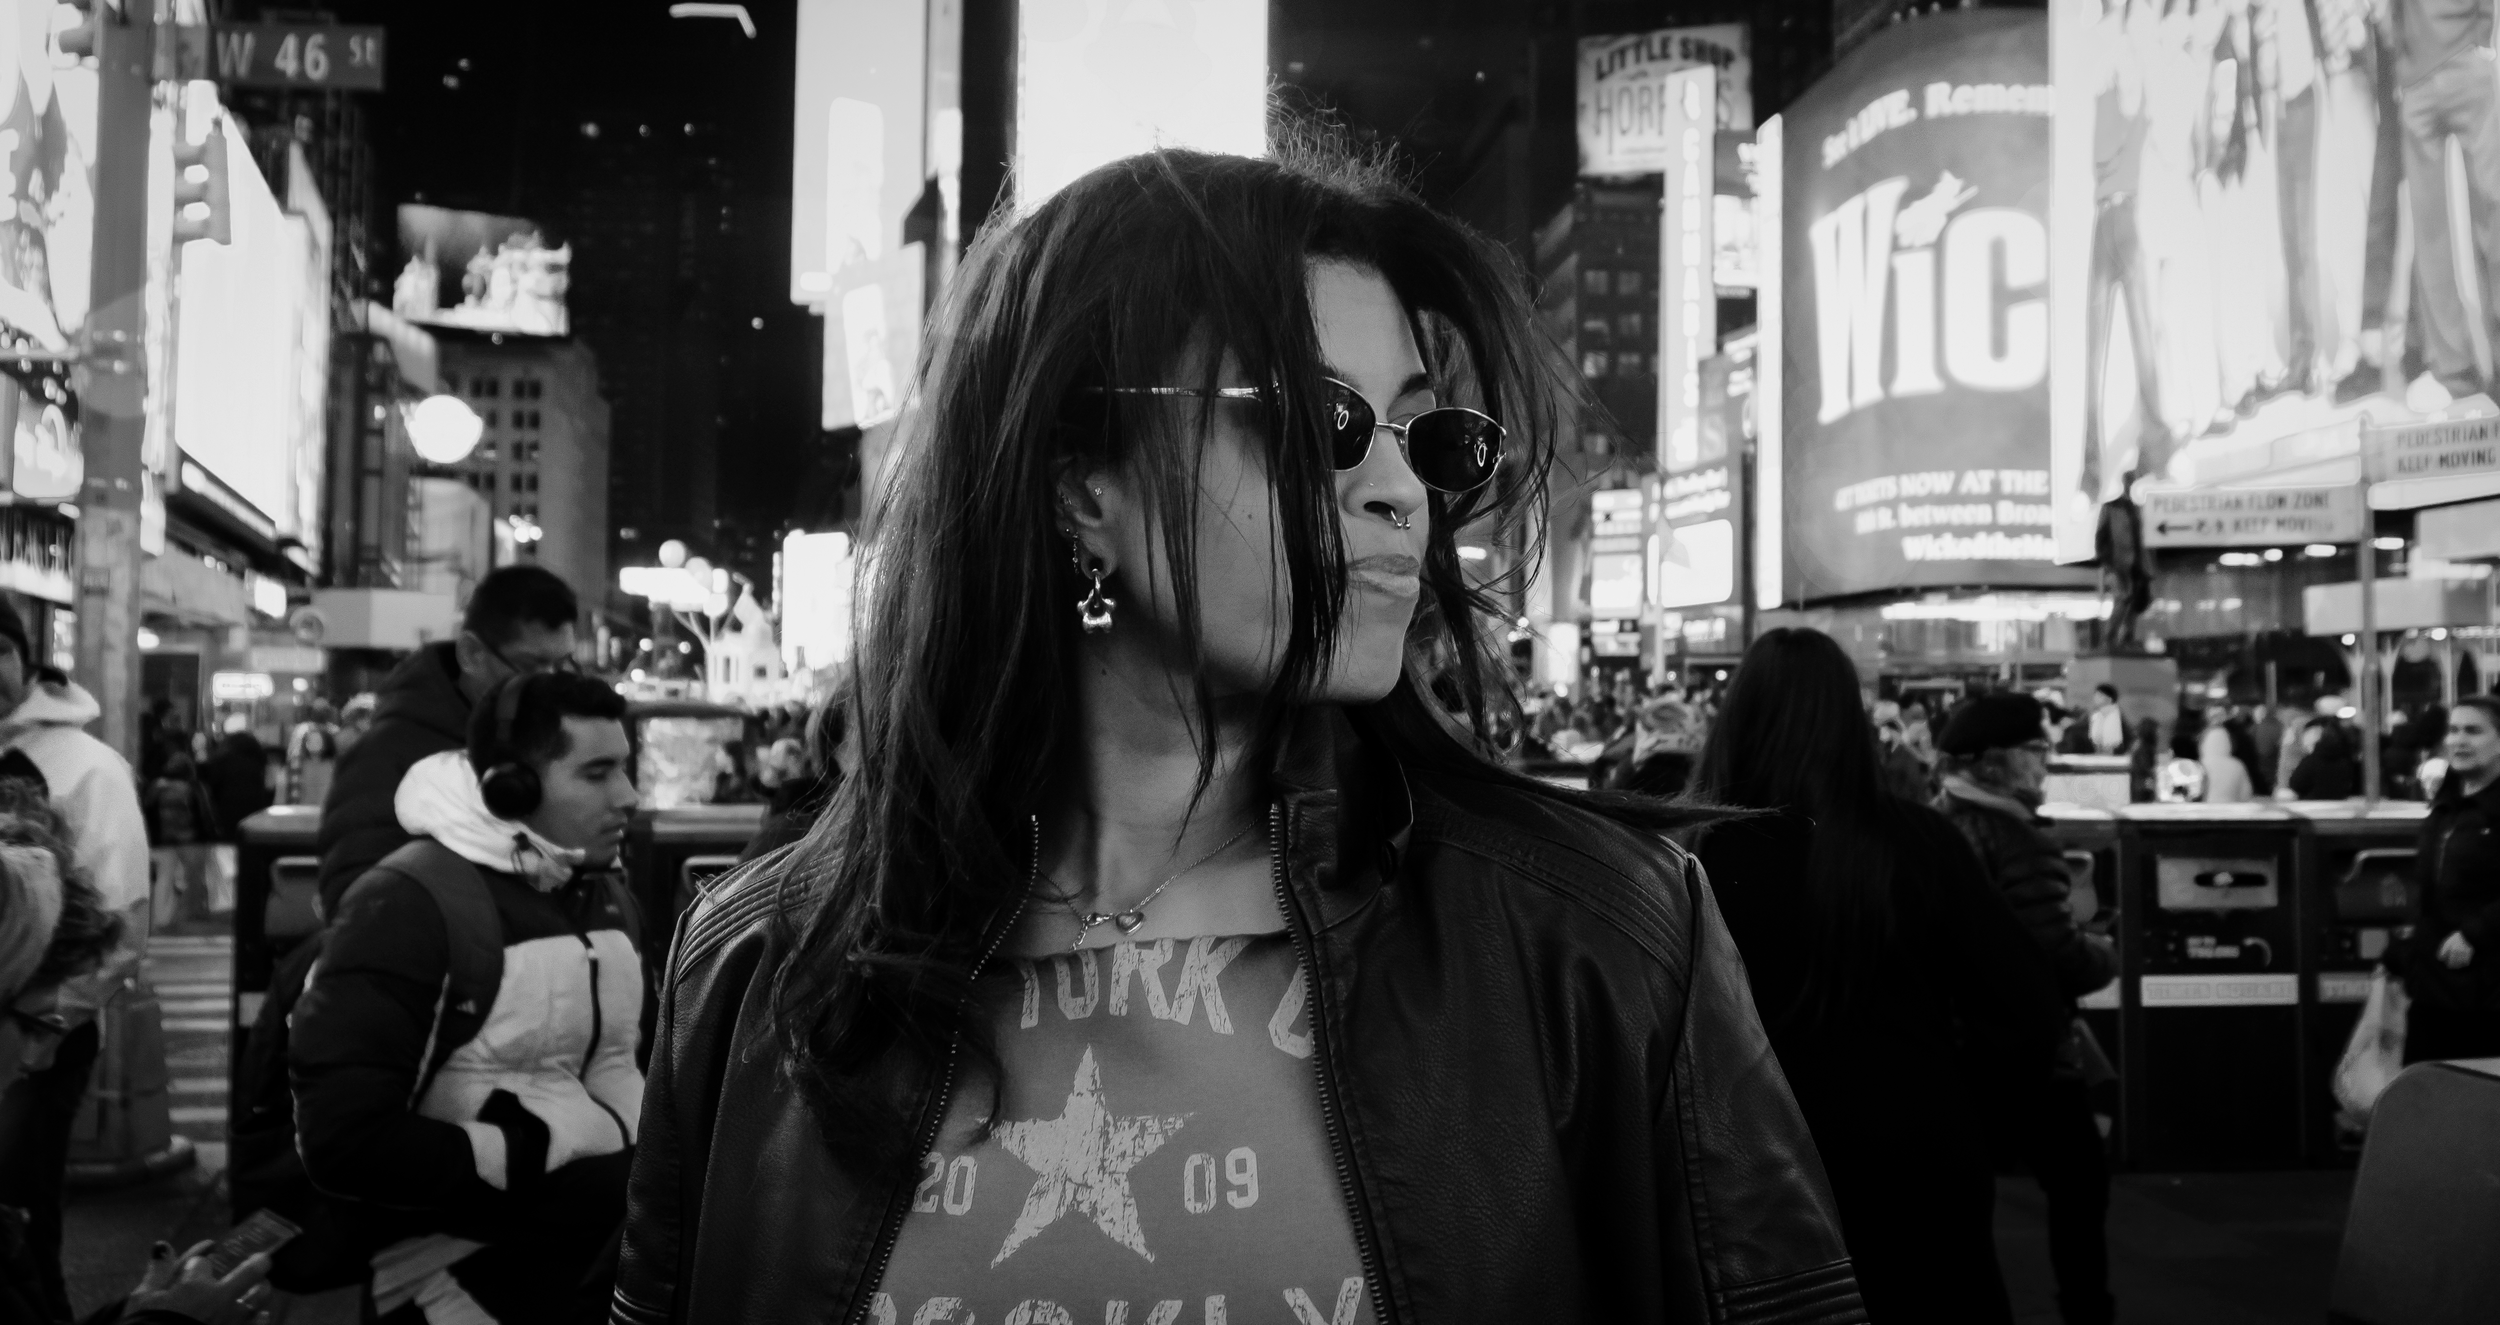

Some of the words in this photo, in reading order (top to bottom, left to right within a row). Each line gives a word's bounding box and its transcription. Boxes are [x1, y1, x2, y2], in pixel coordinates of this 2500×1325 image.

[216, 31, 256, 79] W
[274, 31, 330, 82] 46
[1596, 36, 1671, 82] LITTLE
[1679, 36, 1736, 72] SHOP
[2438, 446, 2497, 468] MOVING
[1899, 470, 1956, 497] NOW
[1958, 468, 1996, 495] AT
[1998, 468, 2050, 496] THE
[2293, 491, 2330, 509] ZONE
[1898, 502, 1993, 528] between
[912, 1151, 979, 1216] 20
[1183, 1146, 1260, 1215] 09
